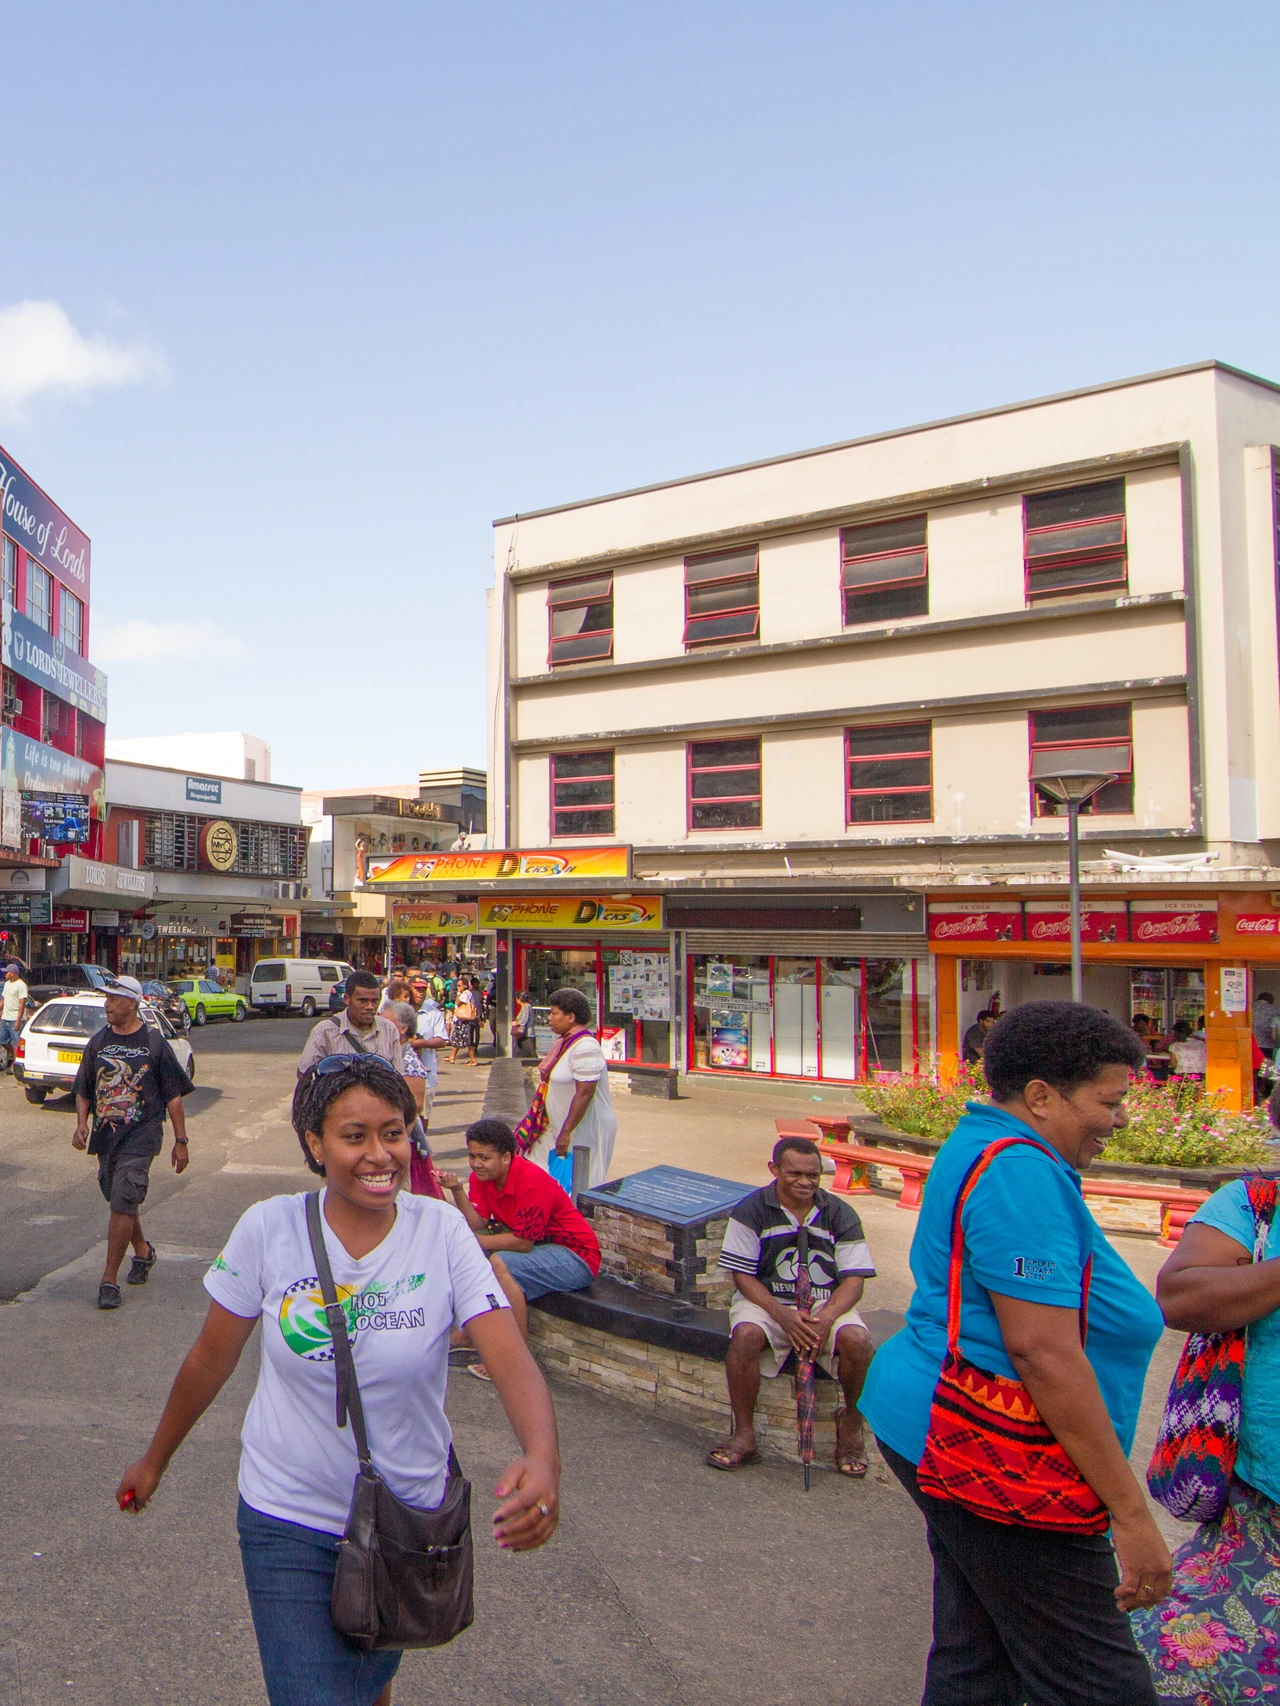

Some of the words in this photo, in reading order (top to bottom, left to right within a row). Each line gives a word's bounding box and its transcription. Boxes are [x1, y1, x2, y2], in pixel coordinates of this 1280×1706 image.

[37, 521, 53, 556] of
[51, 526, 85, 583] Lords
[26, 640, 57, 680] LORDS
[57, 662, 103, 708] JEWELLERS
[25, 743, 40, 766] Life
[41, 750, 49, 767] is
[50, 757, 62, 772] too
[63, 760, 80, 780] short
[188, 778, 219, 793] Amarsee
[434, 857, 490, 869] PHONE
[85, 866, 106, 886] LORDS
[116, 872, 146, 892] JEWELLERS
[511, 905, 560, 914] PHONE
[935, 914, 988, 938] Coca-Cola
[1137, 913, 1202, 940] Coca-Cola
[1236, 918, 1277, 932] Coca-Cola
[1013, 1256, 1026, 1278] 1
[1026, 1259, 1057, 1269] SPIRIT
[1026, 1266, 1052, 1275] TEAM
[772, 1281, 796, 1293] NEW
[351, 1291, 390, 1311] HOT
[355, 1308, 426, 1331] OCEAN
